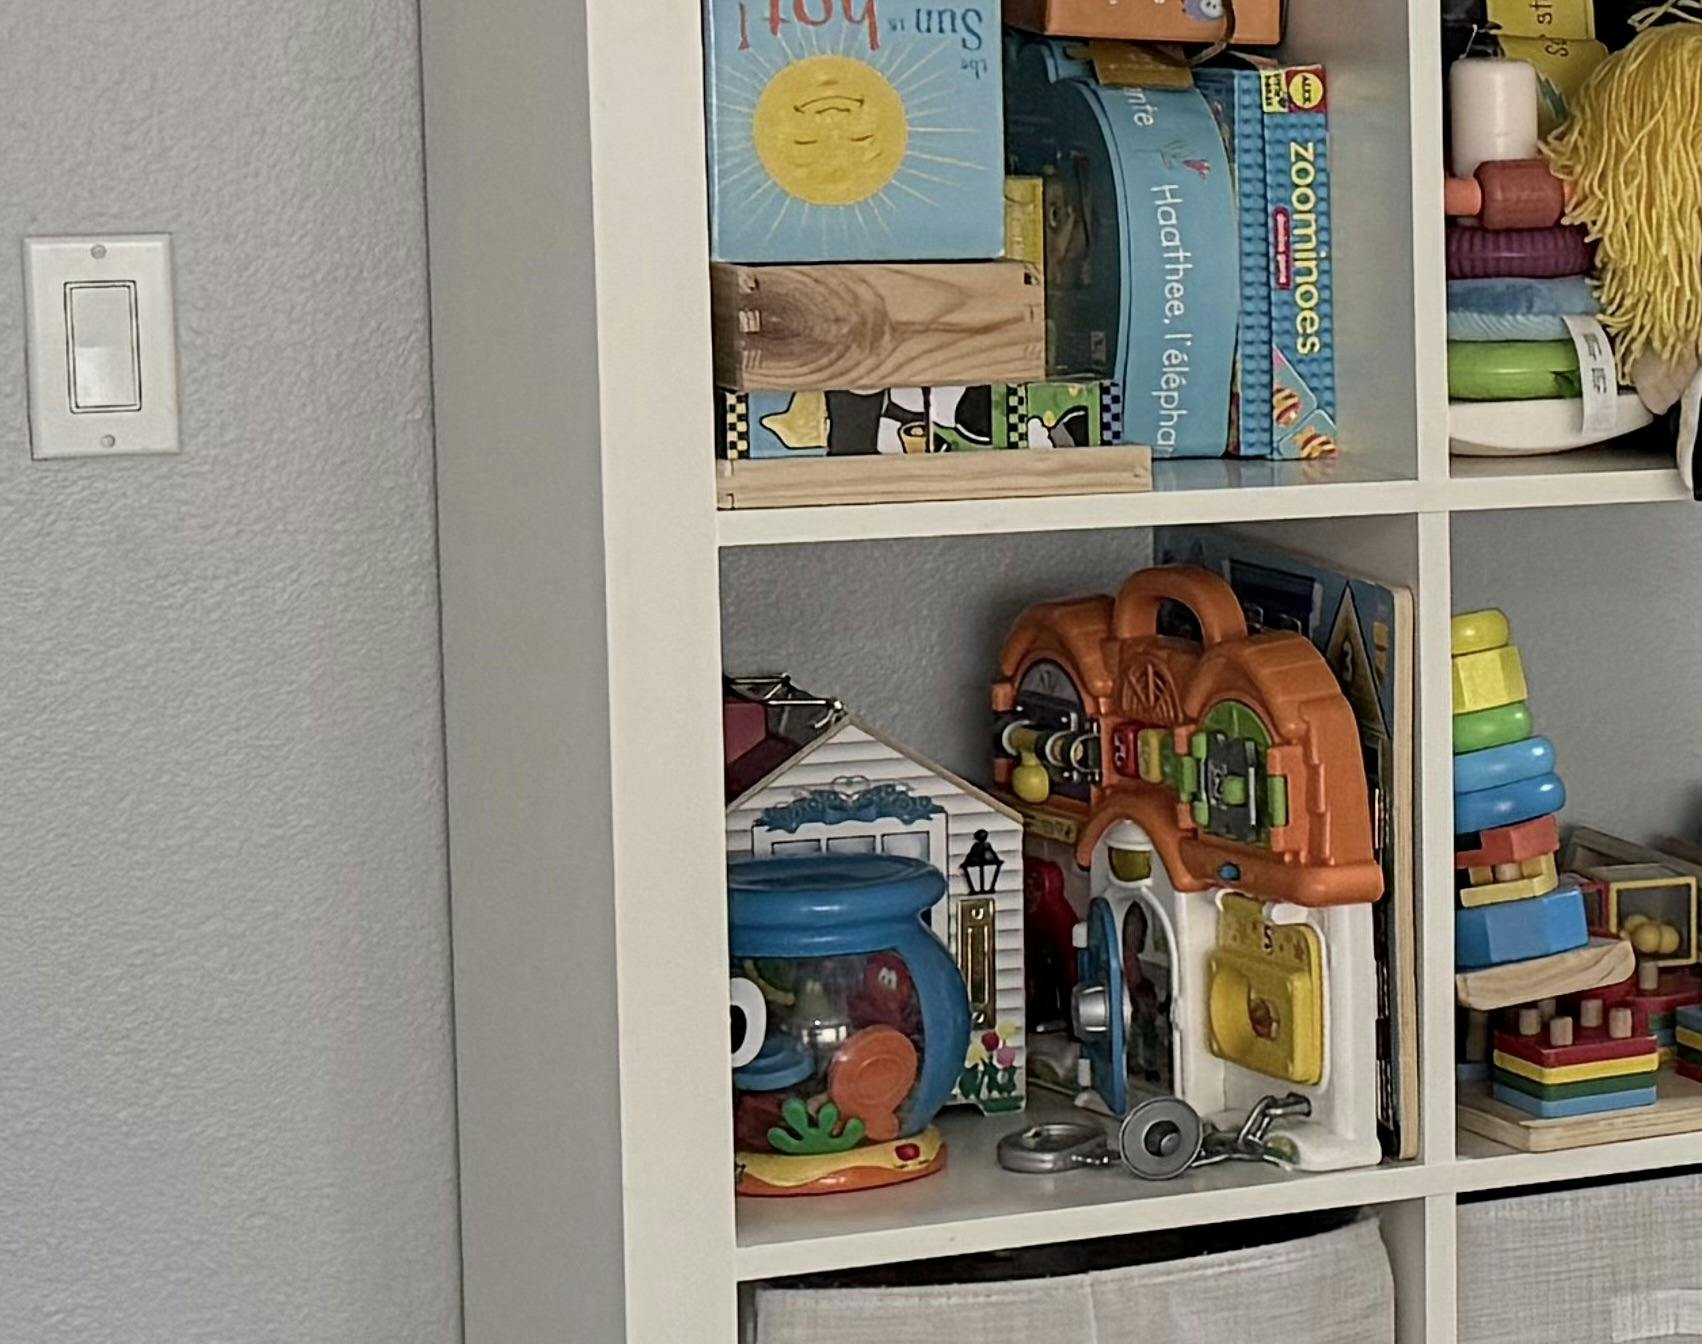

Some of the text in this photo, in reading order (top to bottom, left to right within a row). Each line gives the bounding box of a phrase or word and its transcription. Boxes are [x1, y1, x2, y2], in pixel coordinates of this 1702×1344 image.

[915, 8, 983, 51] Sun
[1124, 88, 1154, 127] nte
[1151, 185, 1192, 324] Haathee,
[1290, 142, 1319, 354] zoominoes
